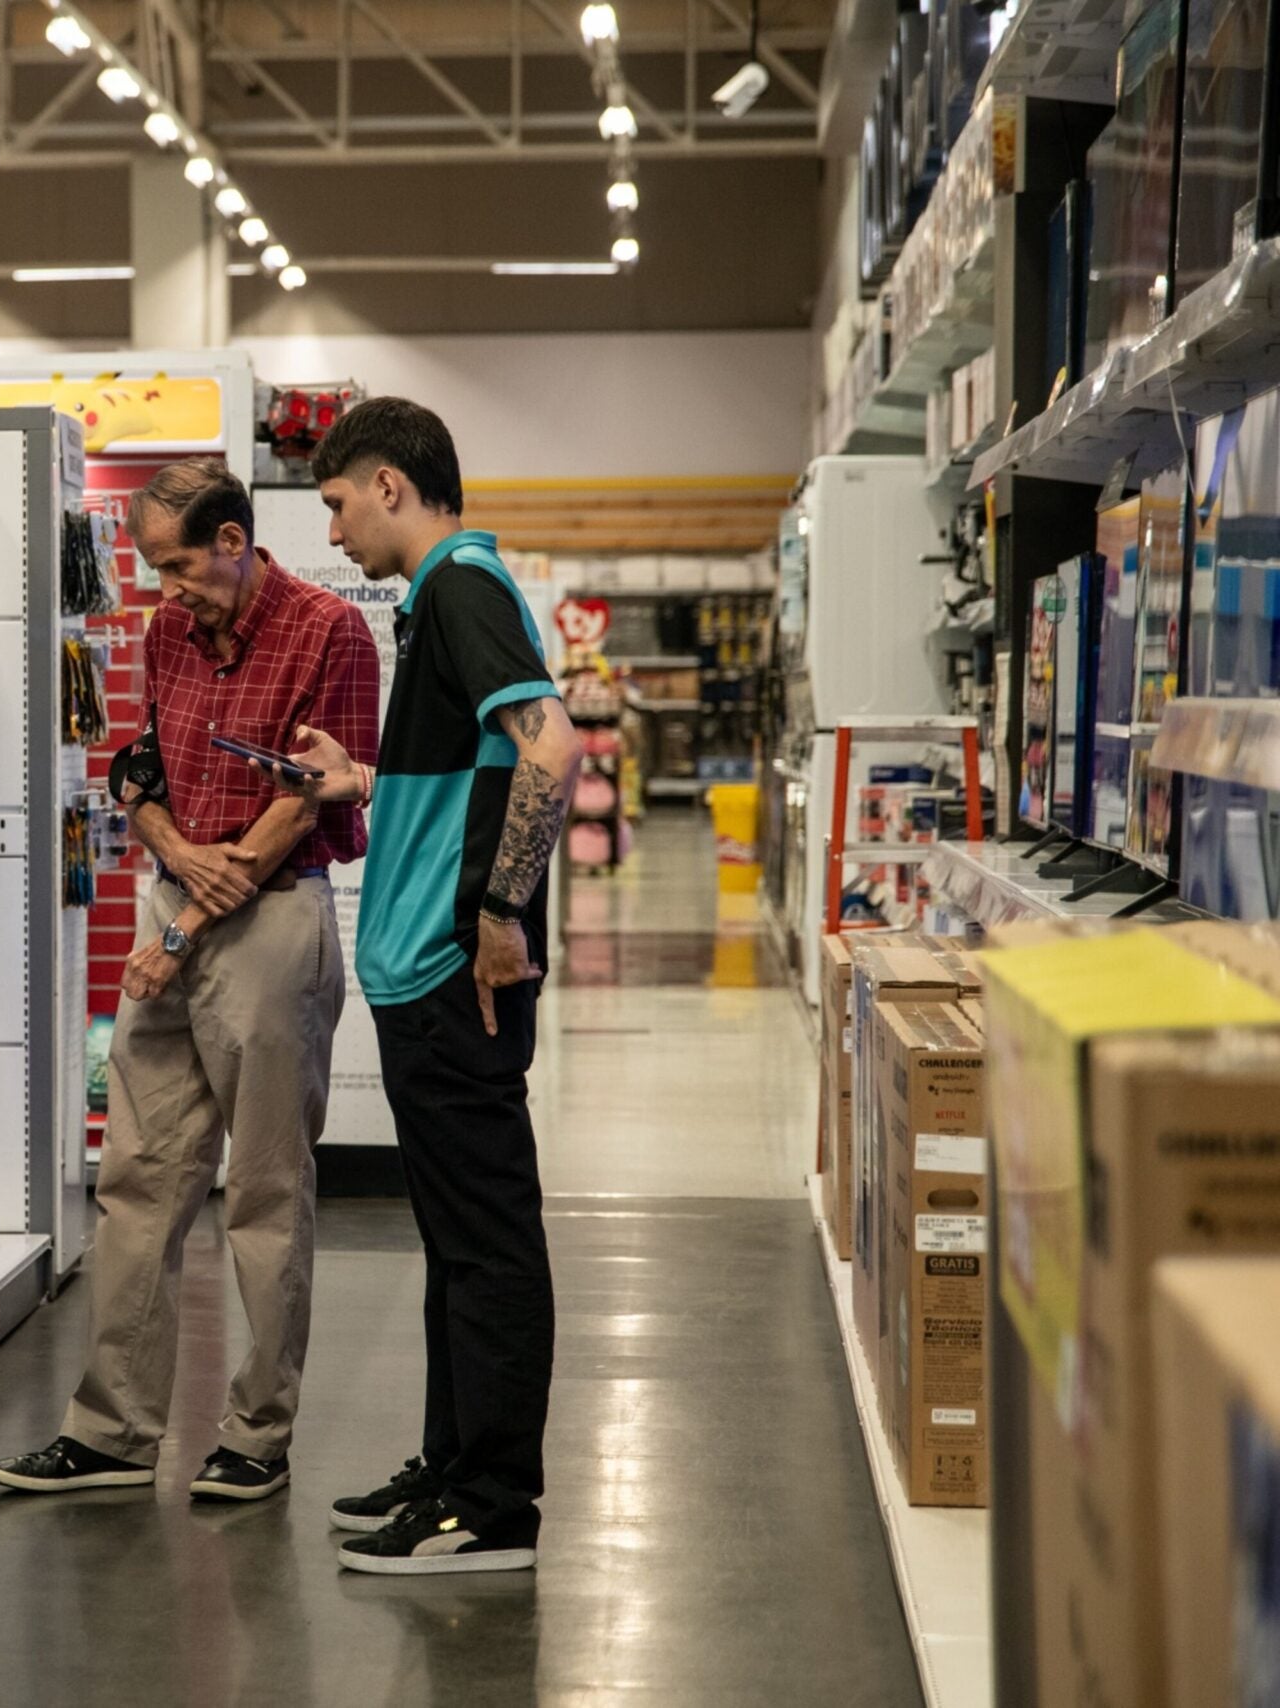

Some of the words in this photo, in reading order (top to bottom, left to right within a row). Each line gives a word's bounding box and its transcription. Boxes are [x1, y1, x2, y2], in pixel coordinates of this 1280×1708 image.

[296, 564, 360, 582] nuestro
[935, 1111, 966, 1120] NETFLIX
[929, 1257, 976, 1269] GRATIS
